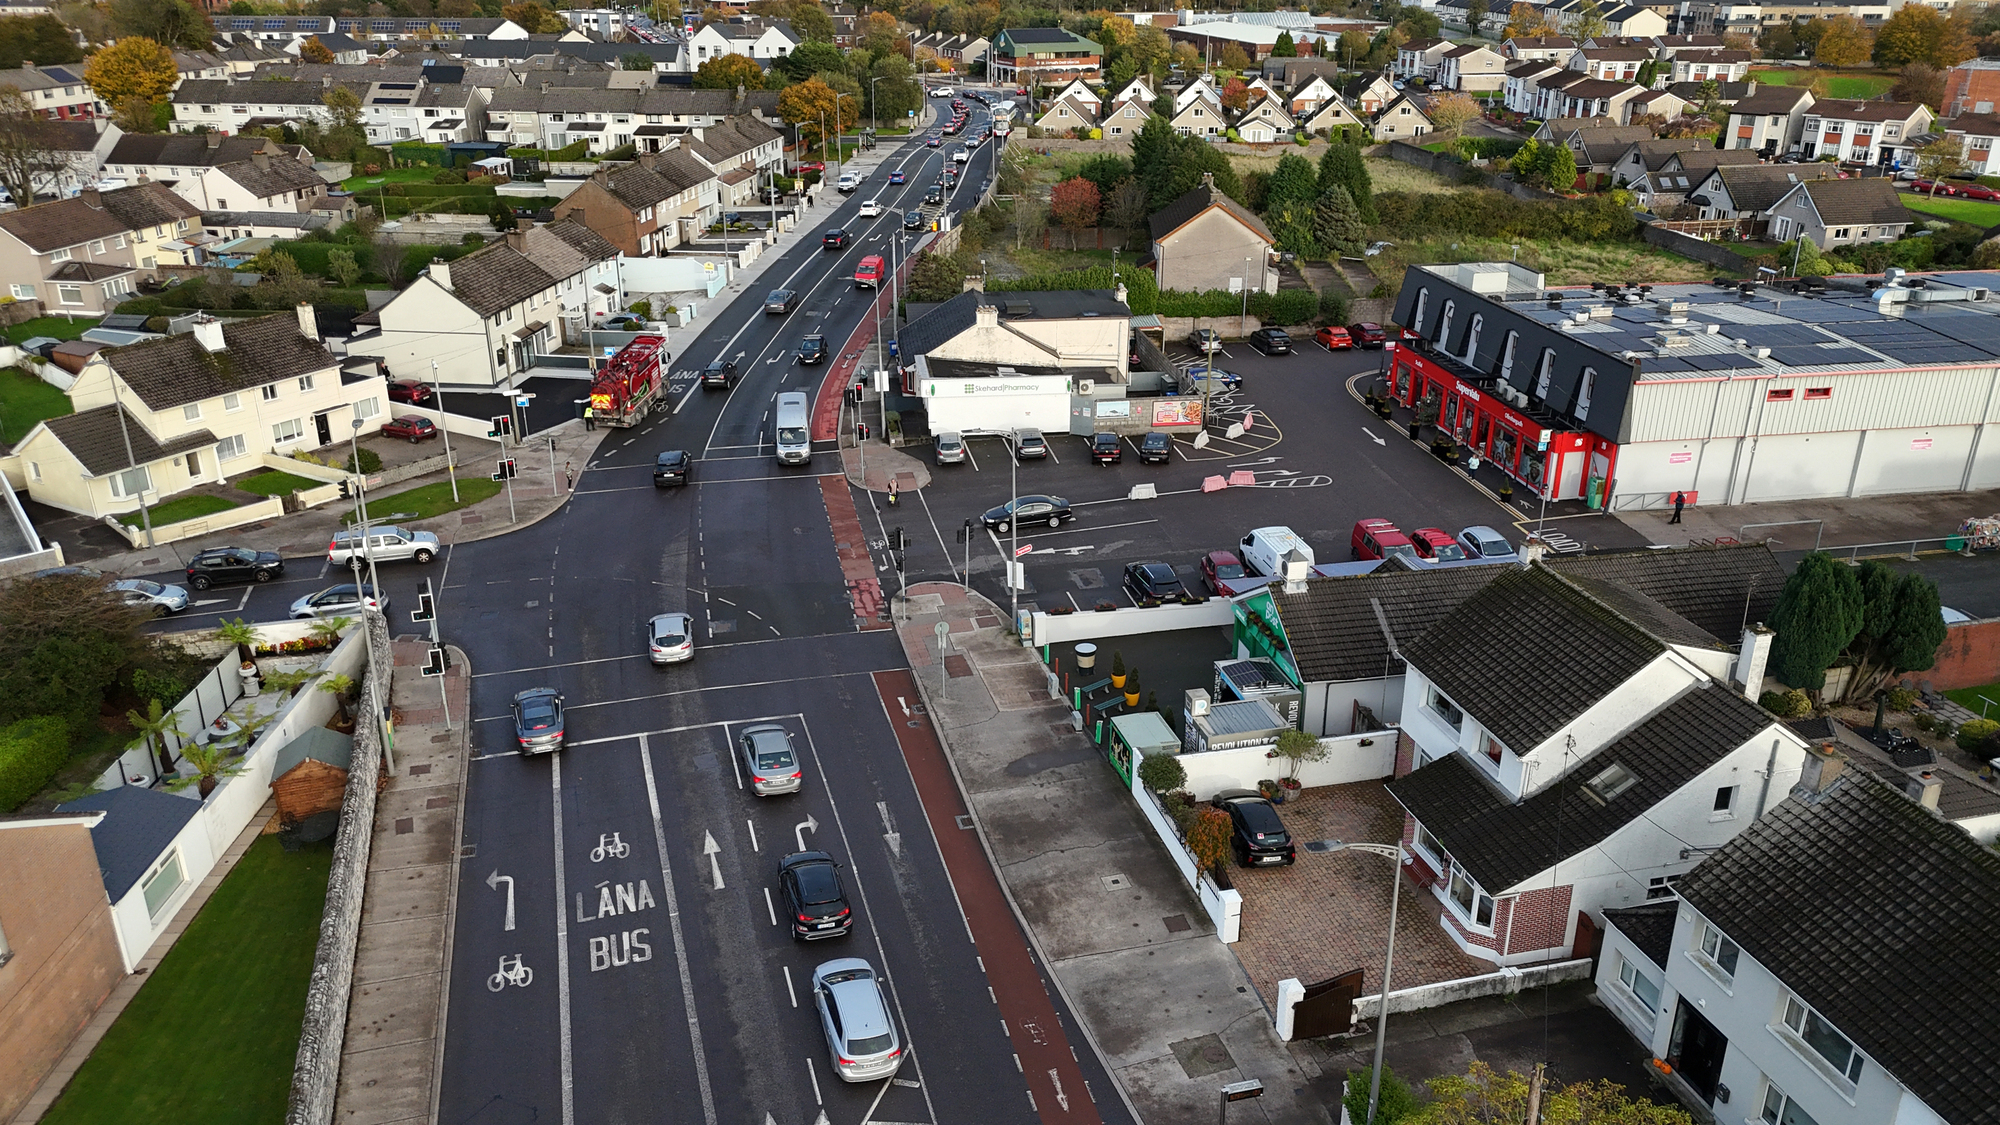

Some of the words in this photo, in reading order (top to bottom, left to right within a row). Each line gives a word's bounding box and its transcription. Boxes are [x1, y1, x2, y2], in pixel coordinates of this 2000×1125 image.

[670, 369, 699, 379] ÁNA
[1004, 384, 1039, 392] Pharmacy
[1456, 380, 1480, 402] SuperValu
[576, 880, 656, 923] LÁNA
[590, 928, 652, 972] BUS
